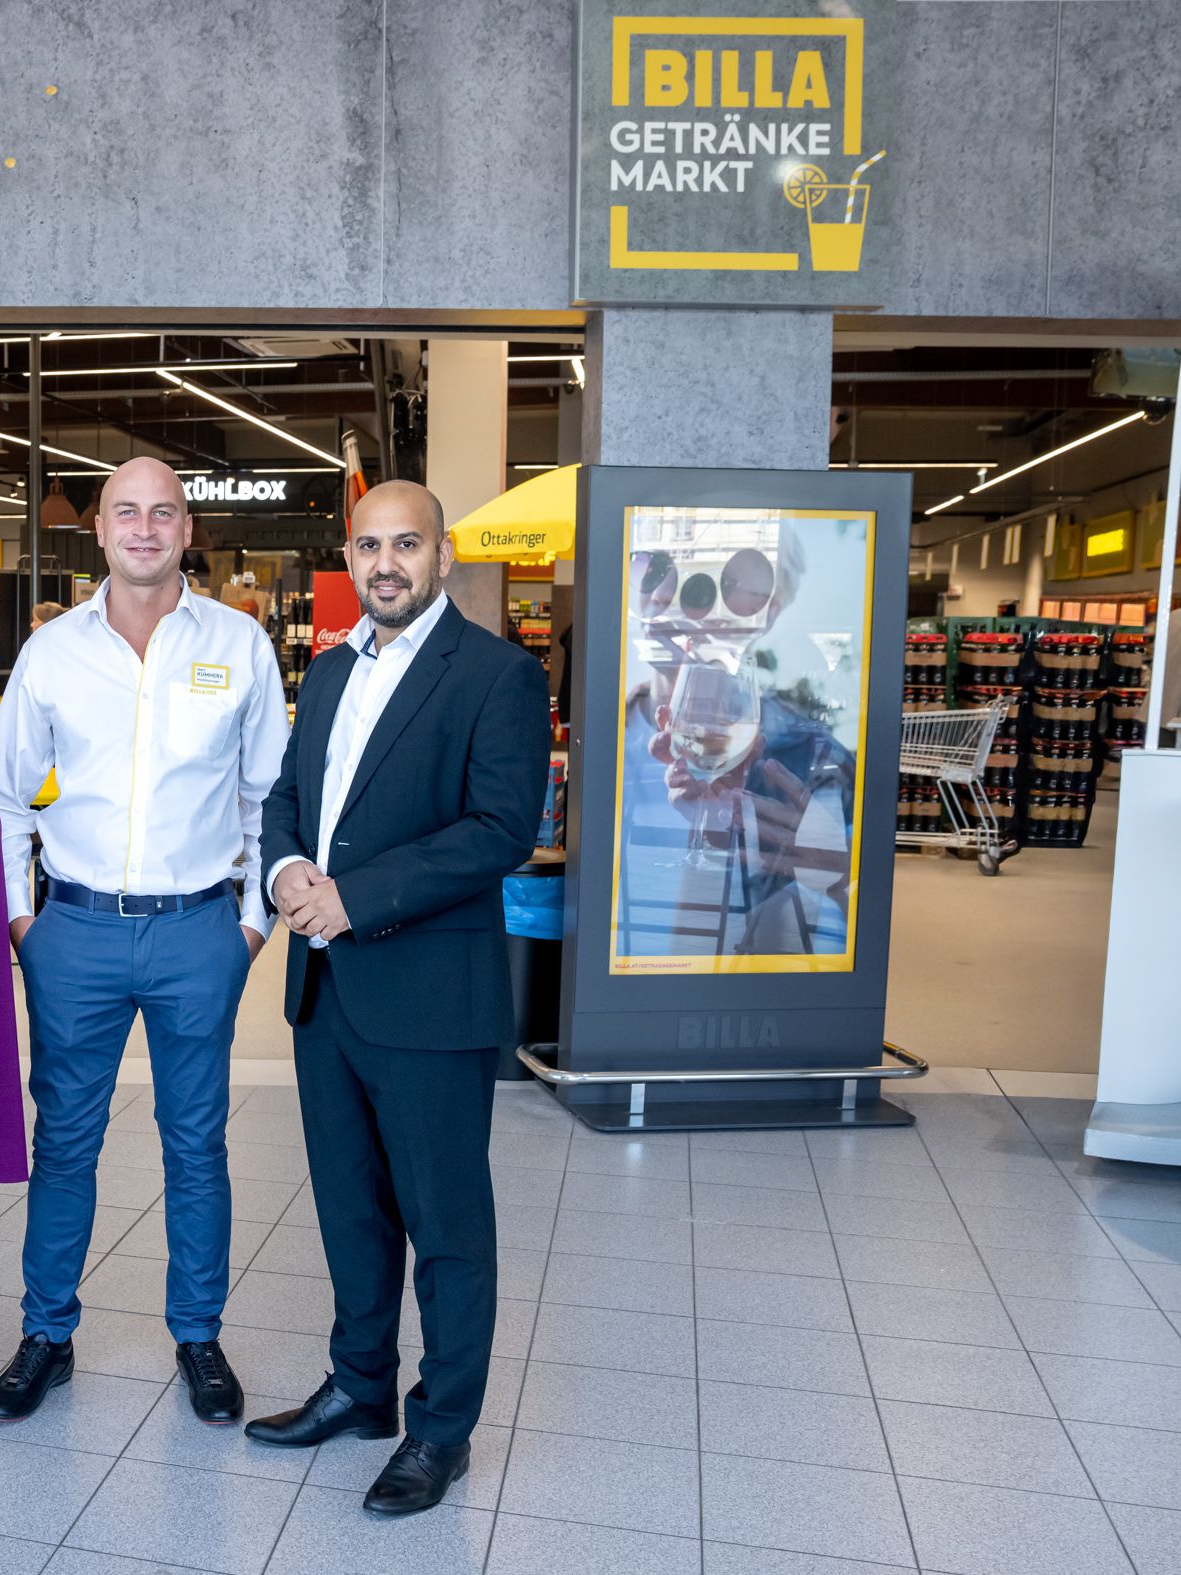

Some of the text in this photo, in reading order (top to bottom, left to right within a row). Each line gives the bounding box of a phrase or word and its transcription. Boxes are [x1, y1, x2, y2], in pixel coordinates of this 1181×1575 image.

[644, 49, 831, 108] BILLA
[609, 113, 831, 155] GETRÄNKE
[609, 159, 754, 193] MARKT
[182, 476, 287, 501] KÜHLBOX
[481, 531, 546, 548] Ottakringer
[677, 1015, 781, 1048] BILLA
